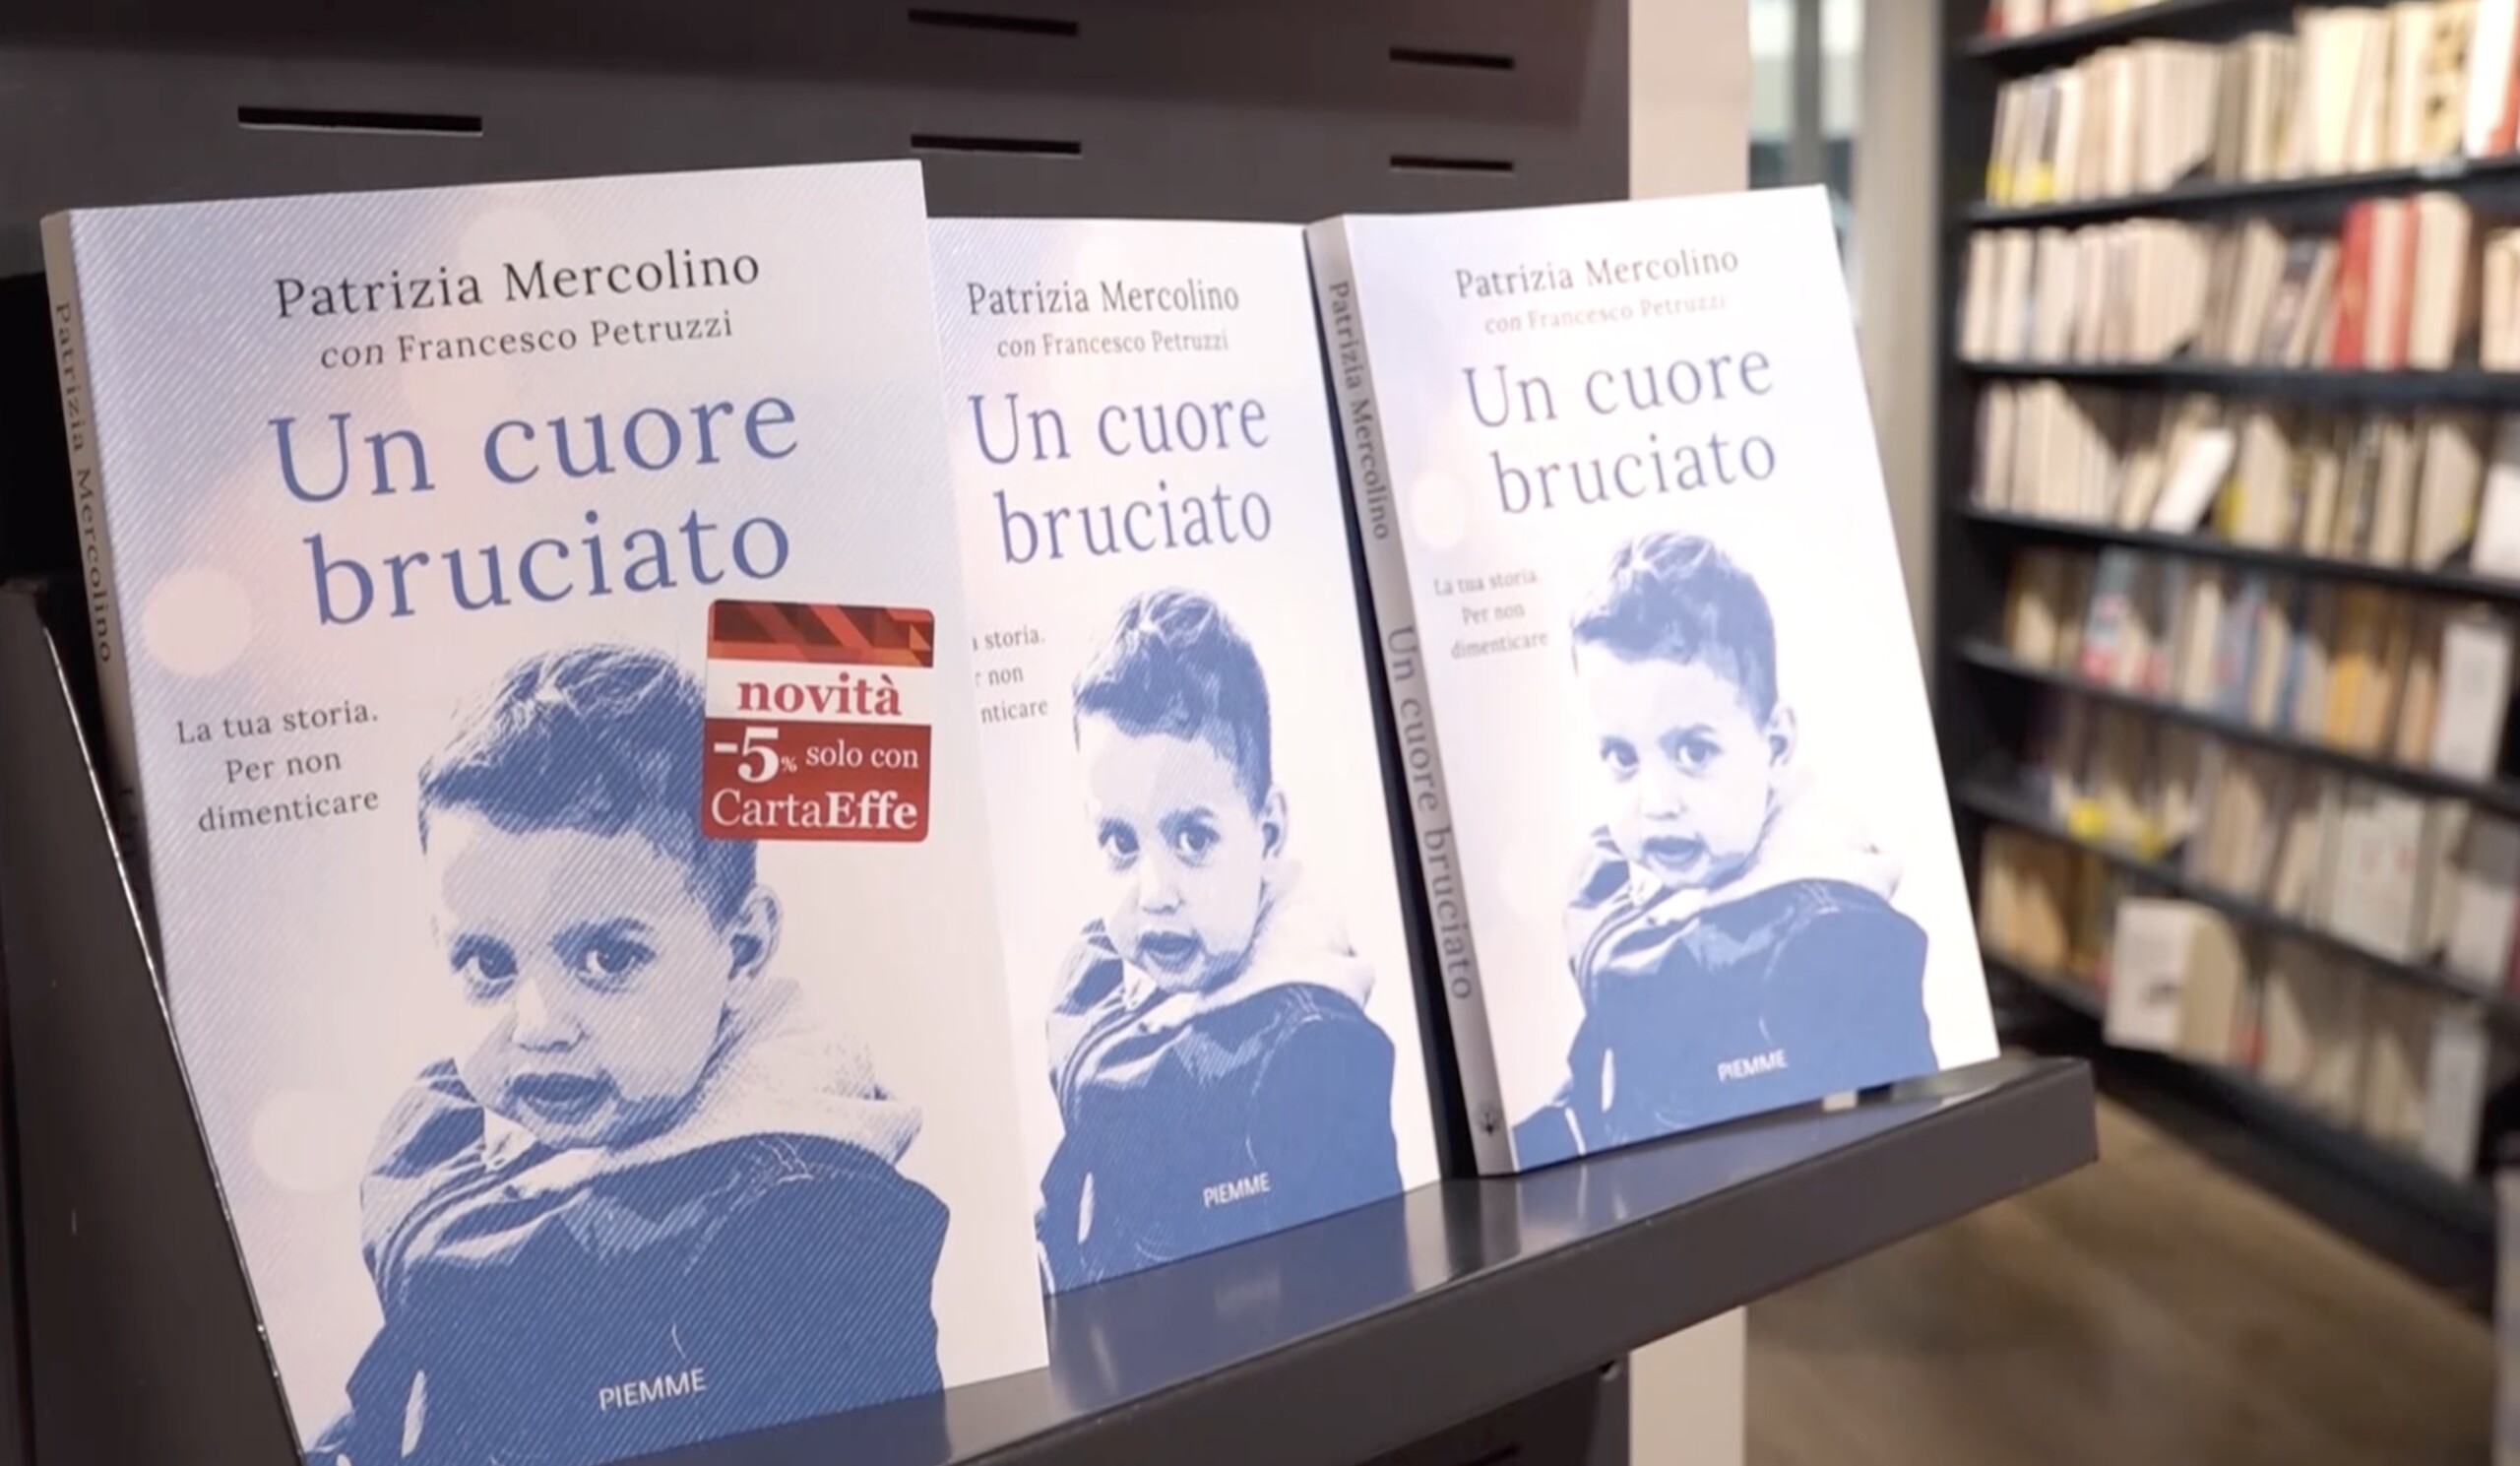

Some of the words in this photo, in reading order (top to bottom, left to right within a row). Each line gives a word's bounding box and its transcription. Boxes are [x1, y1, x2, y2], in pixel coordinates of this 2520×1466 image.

[276, 267, 483, 320] Patrizia
[503, 247, 762, 303] Mercolino
[1456, 263, 1574, 299] Patrizia
[1585, 248, 1739, 292] Mercolino
[966, 280, 1091, 316] Patrizia
[1099, 278, 1240, 314] Mercolino
[1484, 314, 1523, 335] con
[1528, 302, 1634, 331] Francesco
[1640, 293, 1728, 320] Petruzzi
[320, 338, 386, 371] con
[397, 324, 578, 366] Francesco
[590, 310, 734, 349] Petruzzi
[996, 336, 1038, 358] con
[1043, 332, 1147, 358] Francesco
[1152, 329, 1230, 353] Petruzzi
[1462, 364, 1559, 428] Un
[1585, 348, 1774, 415] cuore
[968, 392, 1071, 466] Un
[1098, 397, 1270, 457] cuore
[1329, 281, 1362, 391] Patrizia
[1349, 399, 1389, 541] Mercolino
[268, 412, 436, 504] Un
[483, 393, 800, 486] cuore
[56, 301, 85, 453] Patrizia
[76, 468, 111, 664] Mercolino
[1489, 430, 1778, 515] bruciato
[992, 478, 1273, 565] bruciato
[303, 509, 790, 627] bruciato
[1433, 578, 1454, 597] La
[1457, 576, 1484, 594] tua
[1461, 606, 1488, 626] Per
[1493, 603, 1525, 621] non
[984, 624, 1045, 650] storia.
[1387, 625, 1418, 683] Un
[1450, 632, 1548, 660] dimenticare
[737, 670, 902, 717] novità
[988, 667, 1024, 686] non
[176, 719, 213, 744] La
[222, 715, 272, 739] tua
[283, 699, 379, 733] storia.
[980, 699, 1048, 725] nticare
[225, 758, 276, 785] Per
[285, 751, 342, 777] non
[805, 738, 863, 768] solo
[870, 748, 919, 769] con
[1399, 698, 1438, 813] cuore
[198, 791, 380, 833] dimenticare
[711, 787, 918, 830] CartaEffe
[1423, 824, 1473, 1001] bruciato
[1717, 1049, 1789, 1082] PIEMME
[1203, 1172, 1271, 1208] PIEMME
[598, 1368, 707, 1412] PIEMME
